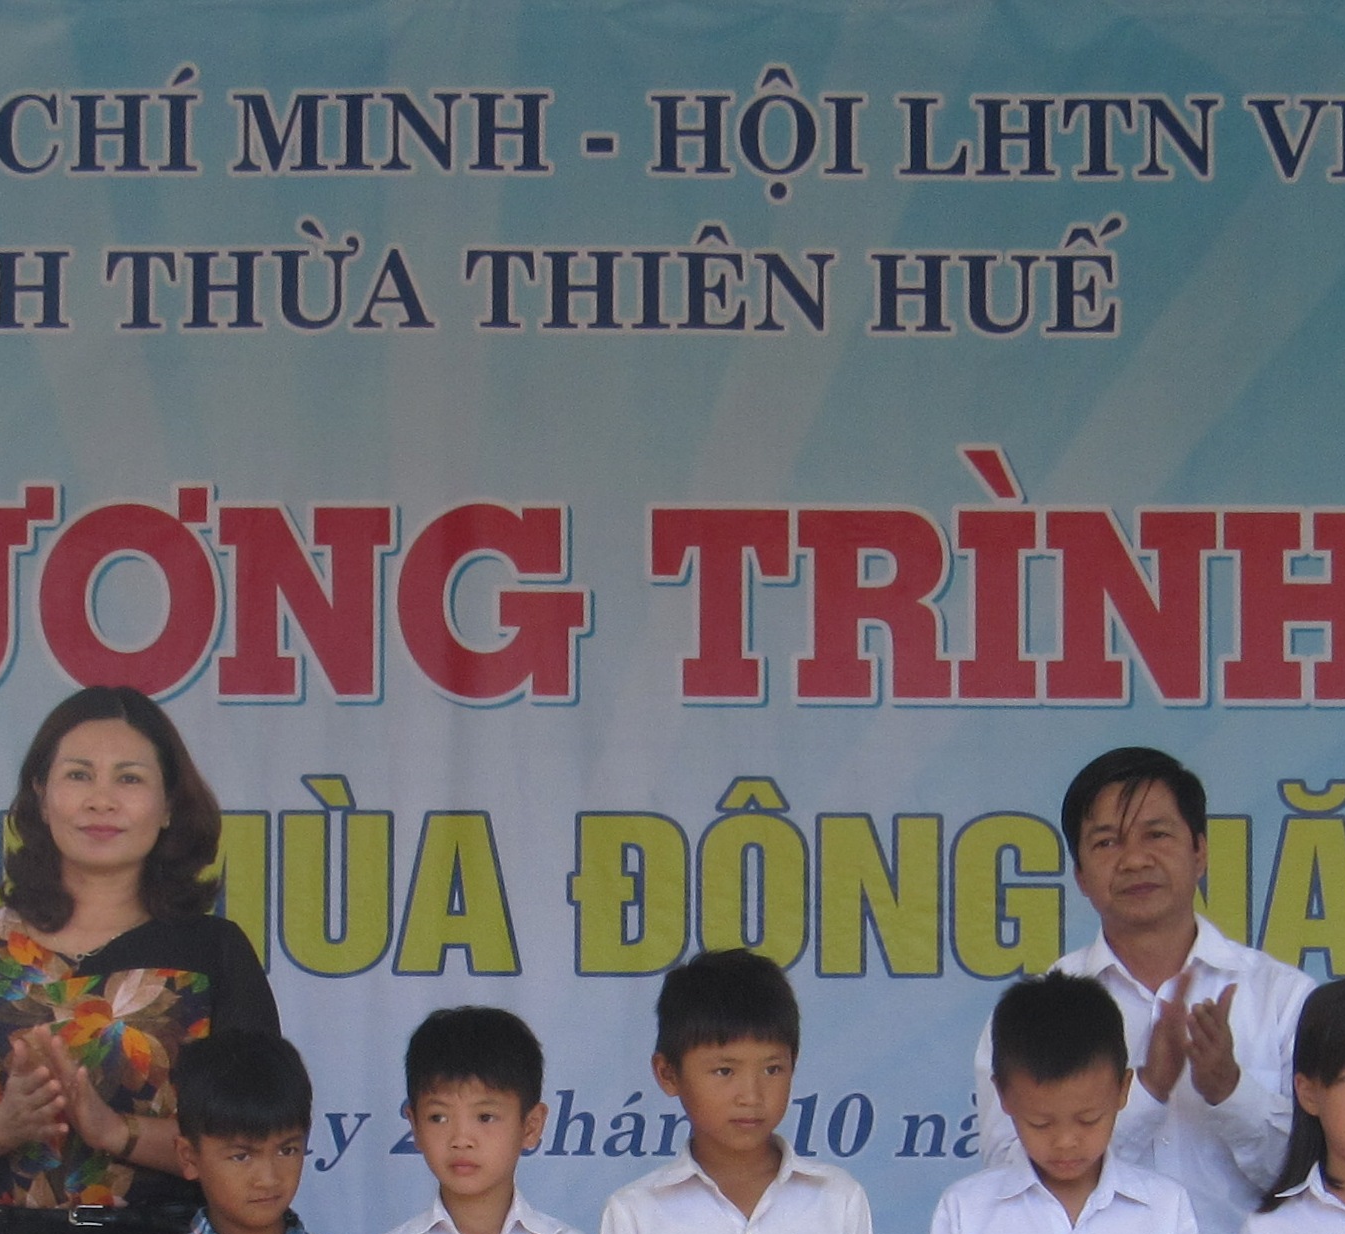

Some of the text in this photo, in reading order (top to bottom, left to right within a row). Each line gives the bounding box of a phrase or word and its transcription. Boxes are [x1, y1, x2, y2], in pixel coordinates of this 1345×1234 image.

[233, 91, 550, 172] MINH
[651, 68, 864, 200] HỘI
[899, 96, 1219, 177] LHTN
[106, 219, 436, 329] THỪA
[465, 224, 834, 331] THIÊN
[870, 216, 1124, 334] HUẾ
[567, 776, 1067, 979] ĐÔNG
[792, 1092, 875, 1158] 10
